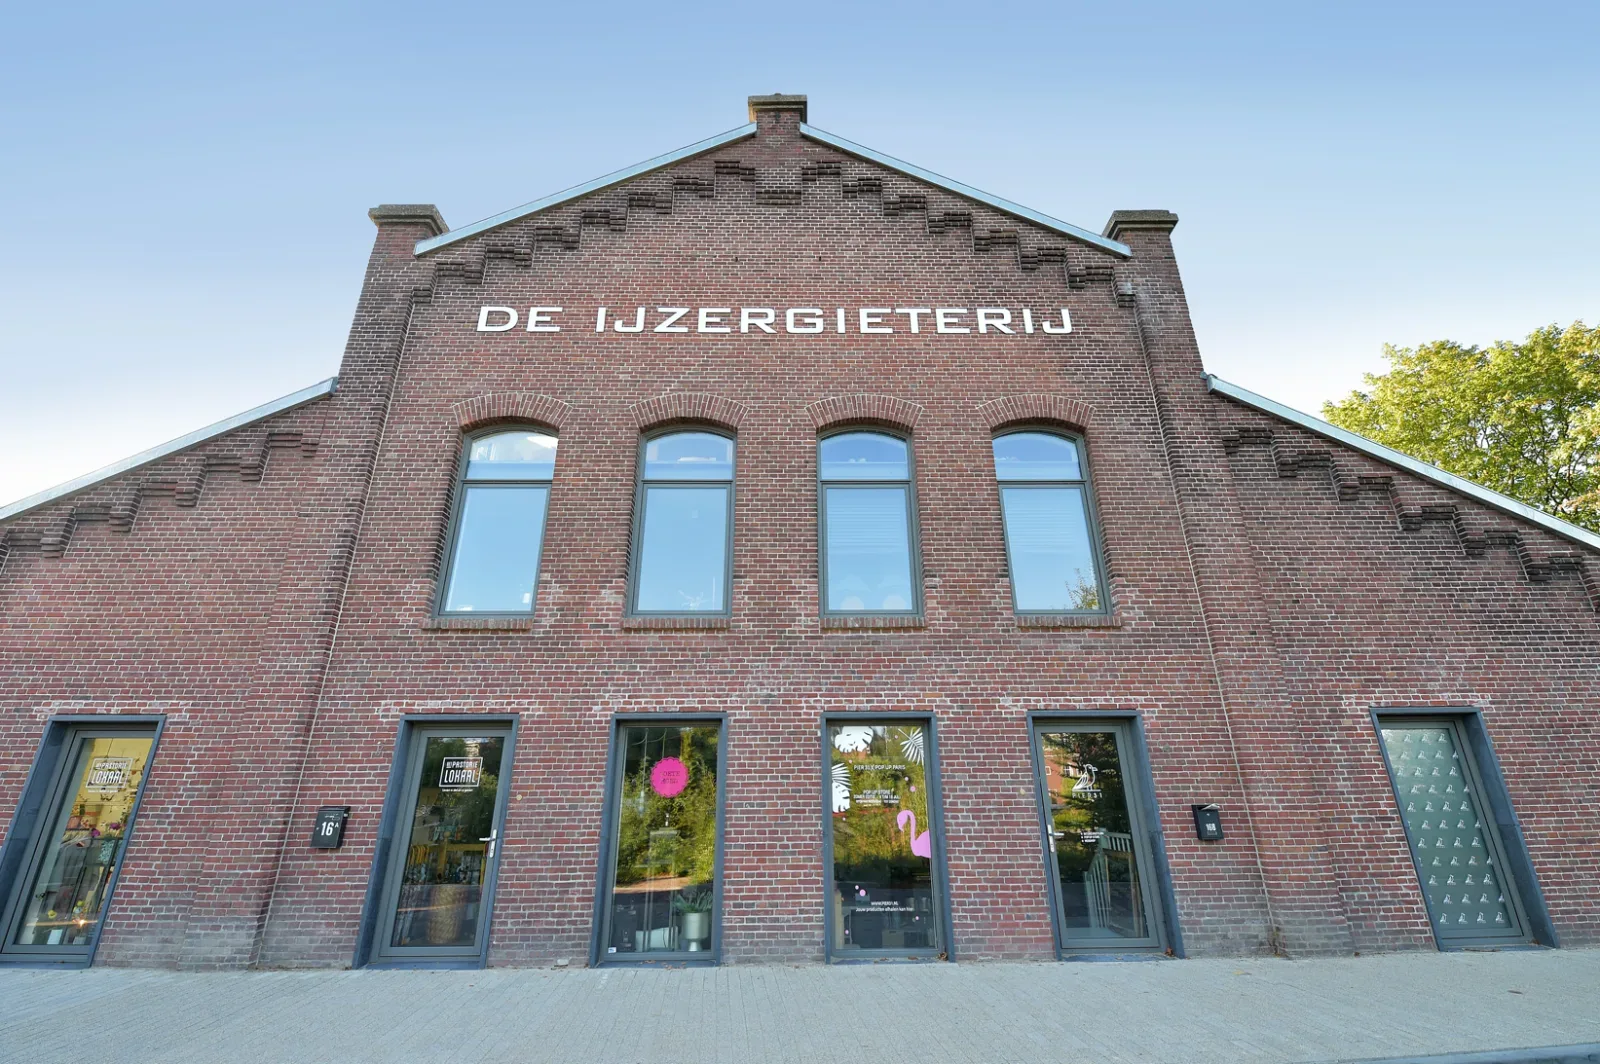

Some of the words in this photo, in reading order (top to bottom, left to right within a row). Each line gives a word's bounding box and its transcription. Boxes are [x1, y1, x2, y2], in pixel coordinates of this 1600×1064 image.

[476, 305, 562, 334] DE
[595, 306, 1073, 336] IJZERGIETERIJ
[91, 770, 124, 784] LOKAAL
[444, 769, 477, 783] LOKAAL
